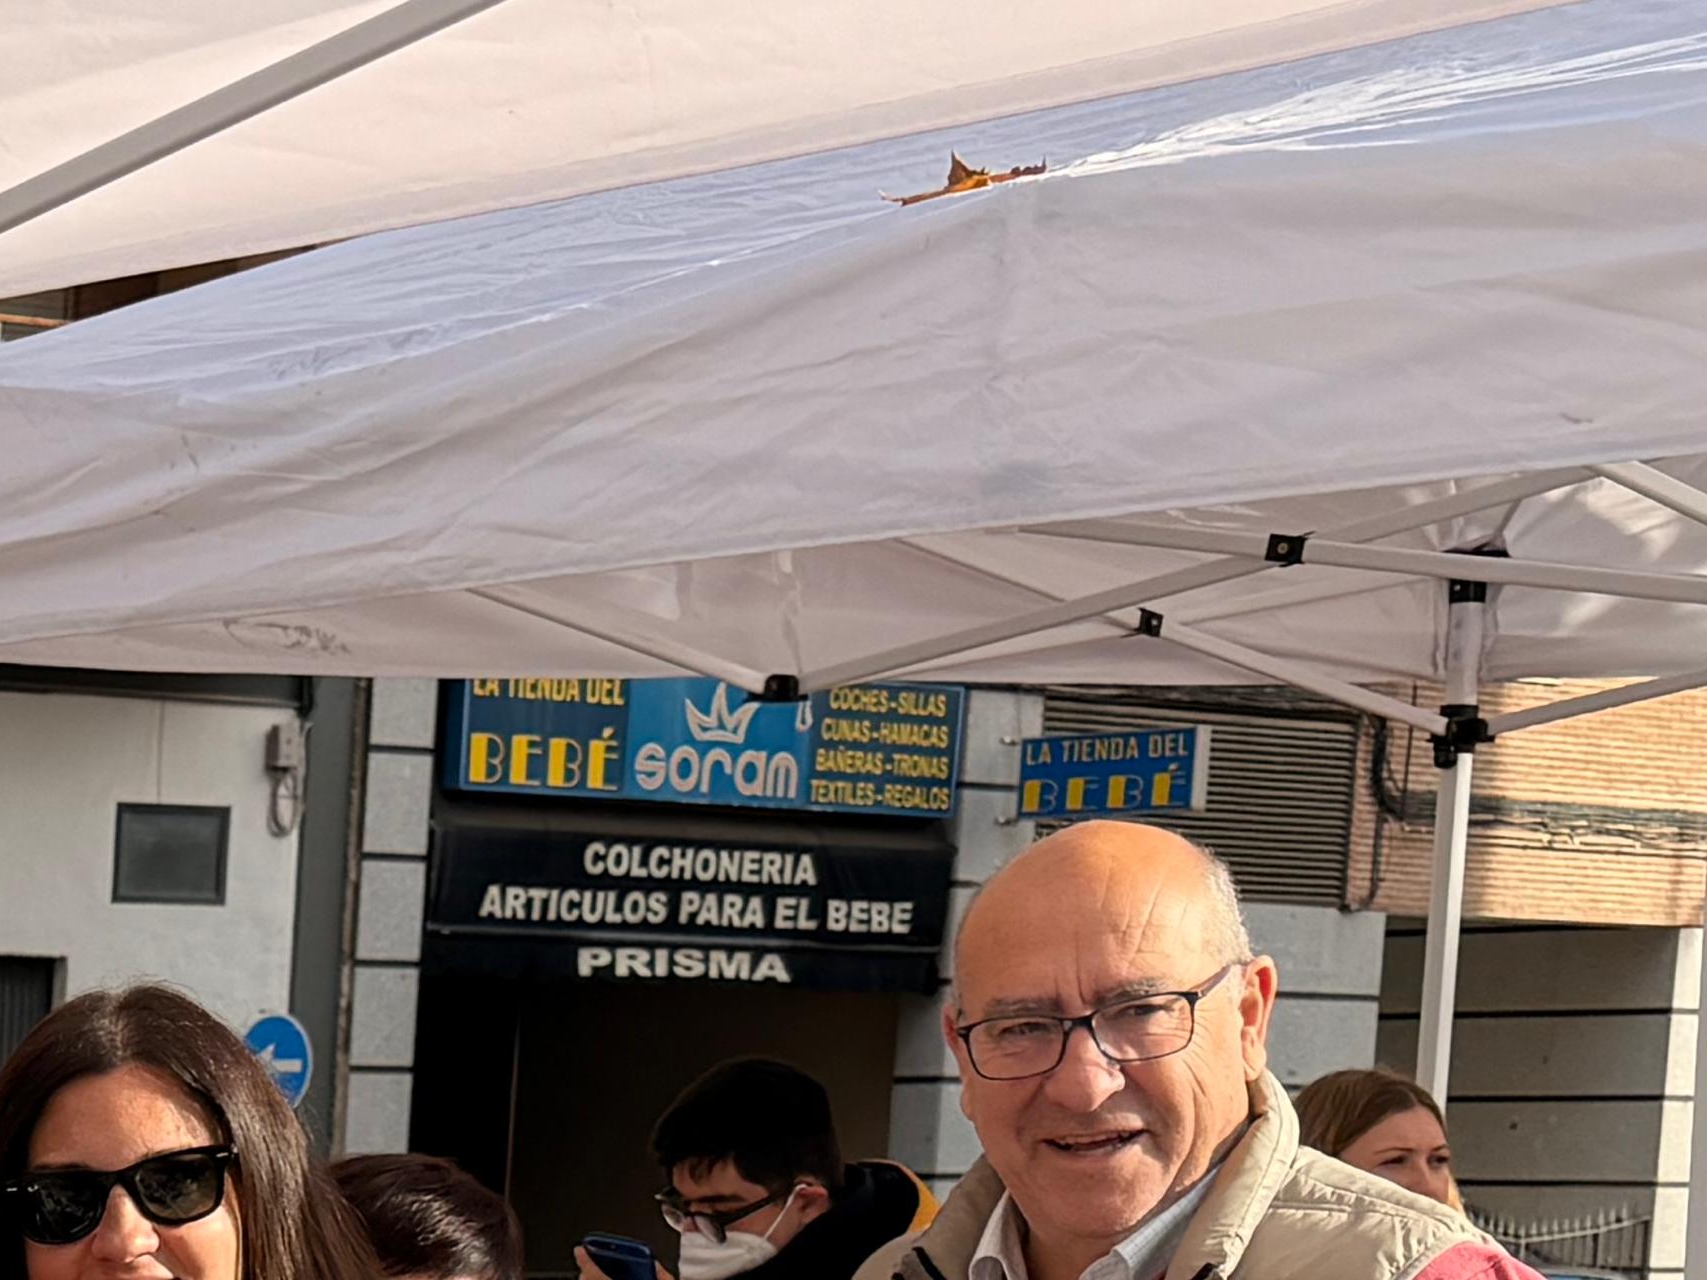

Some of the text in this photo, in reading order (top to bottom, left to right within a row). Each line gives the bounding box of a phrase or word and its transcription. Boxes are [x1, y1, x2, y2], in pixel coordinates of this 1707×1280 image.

[474, 680, 625, 706] LA TIENDA DEL
[469, 726, 620, 791] BEBÉ
[1025, 733, 1190, 767] LA TIENDA DEL
[1021, 762, 1187, 814] BEBÉ
[583, 842, 818, 886] COLCHONERIA
[478, 884, 915, 934] ARTICULOS PARA EL BEBE
[577, 946, 792, 983] PRISMA
